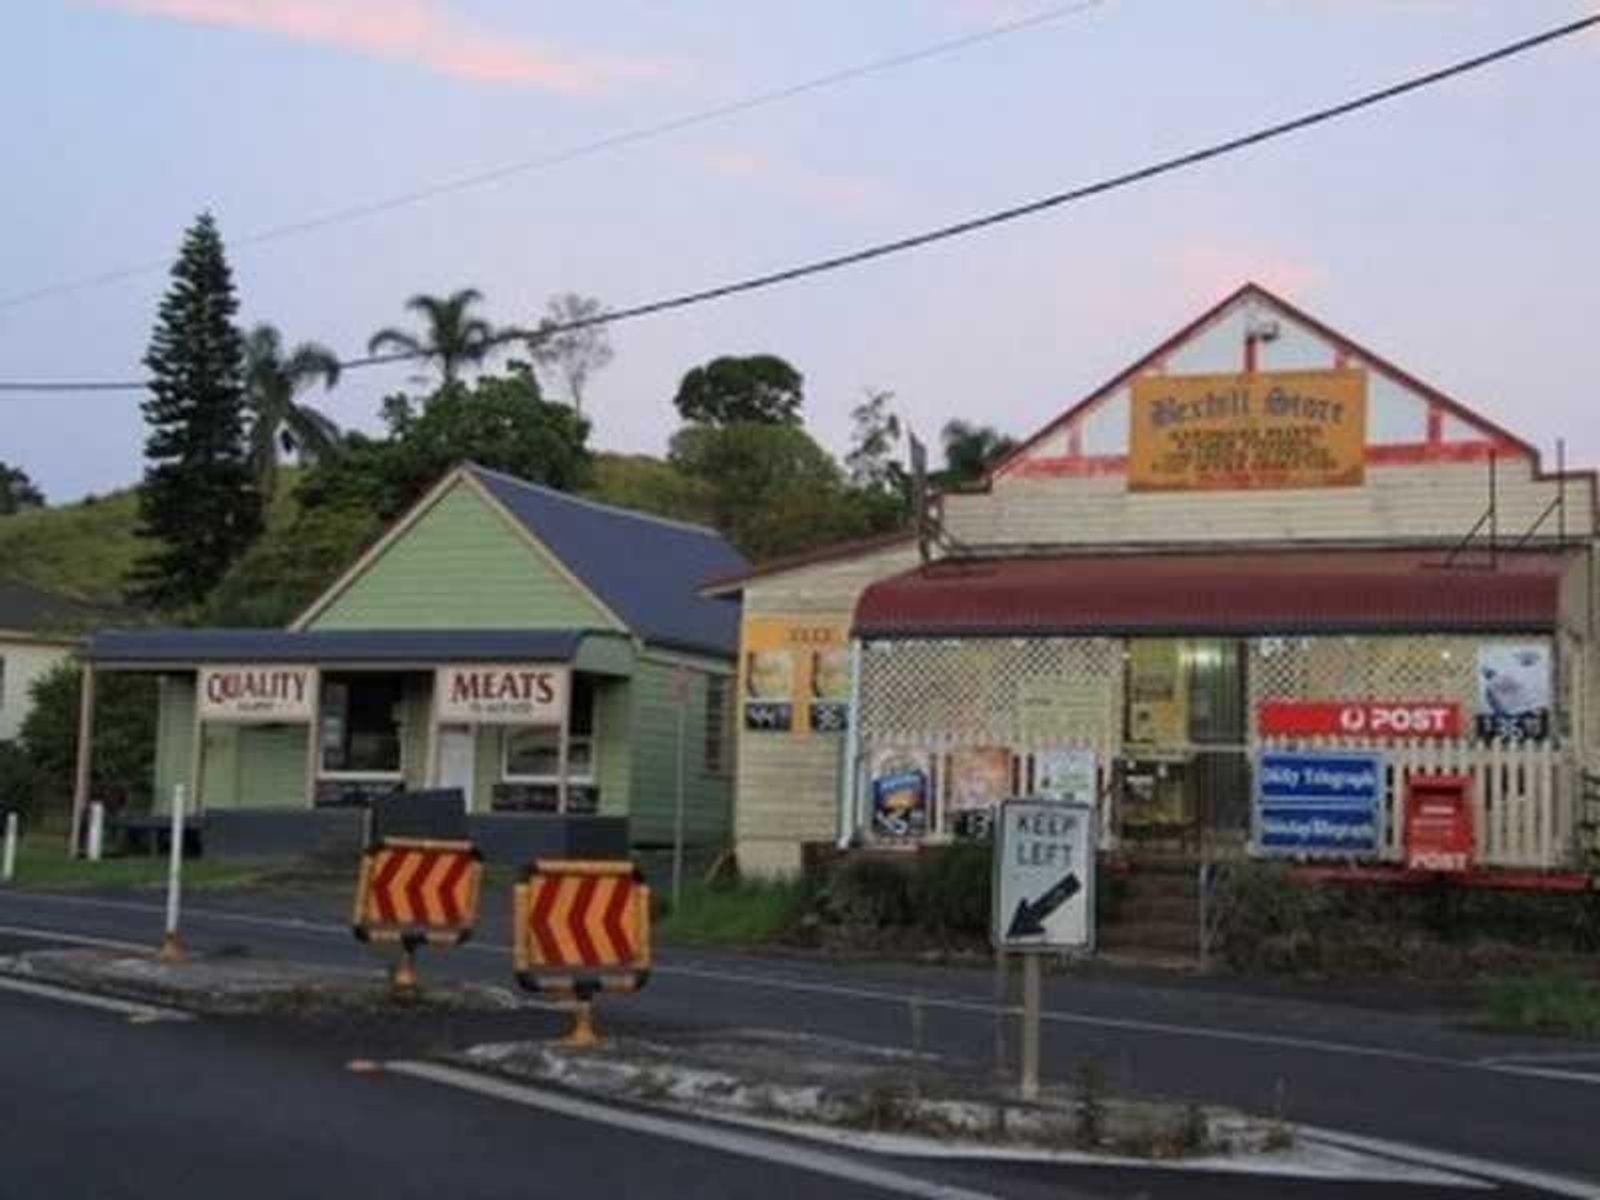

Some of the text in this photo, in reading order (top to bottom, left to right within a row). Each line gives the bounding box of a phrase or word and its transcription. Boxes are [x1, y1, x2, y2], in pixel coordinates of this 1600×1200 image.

[207, 671, 307, 703] QUALITY
[452, 671, 554, 704] MEATS
[1371, 709, 1449, 730] POST
[1017, 815, 1075, 836] KEEP
[1017, 842, 1072, 865] LEFT
[1410, 852, 1467, 871] POST
